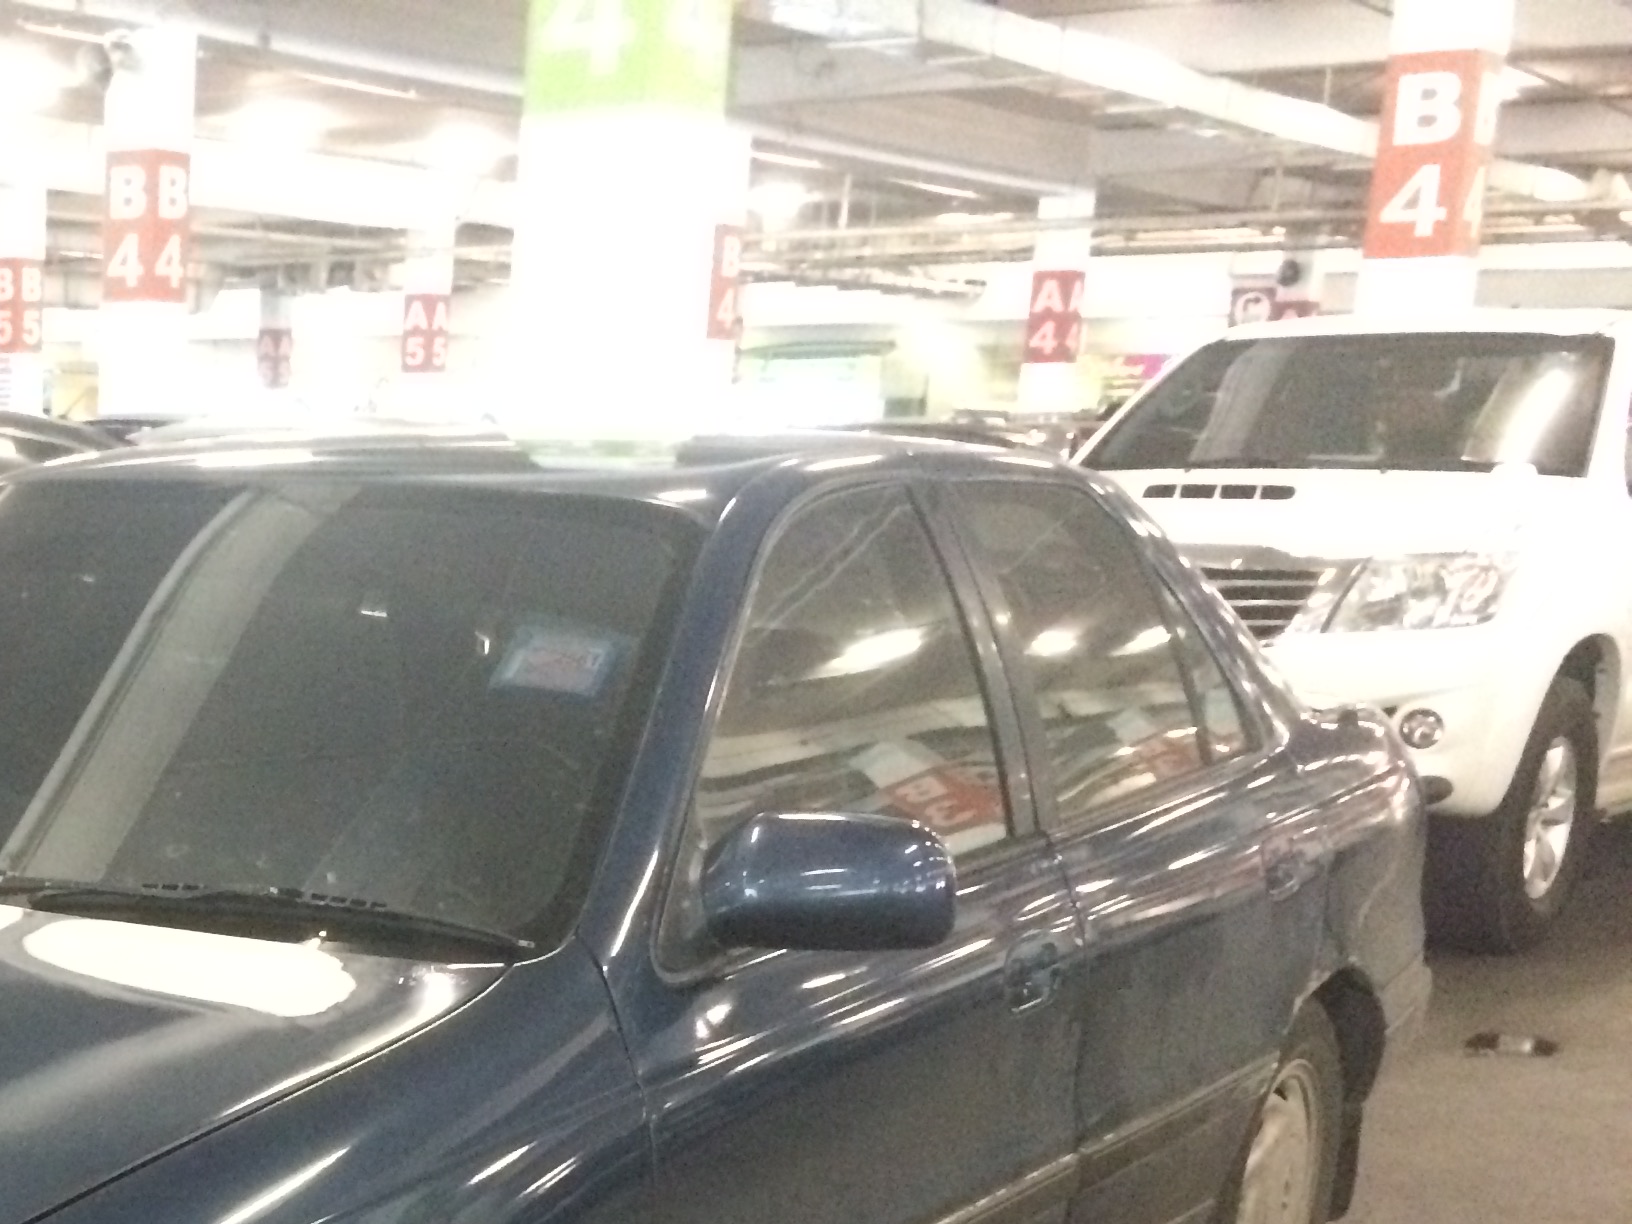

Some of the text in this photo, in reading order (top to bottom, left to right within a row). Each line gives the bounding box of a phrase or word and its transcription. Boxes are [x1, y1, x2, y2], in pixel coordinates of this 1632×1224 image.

[541, 0, 636, 76] 4
[1393, 72, 1462, 145] B
[110, 165, 147, 220] B
[158, 165, 188, 219] B
[1380, 164, 1447, 237] 4
[21, 267, 42, 302] B
[106, 233, 144, 288] 4
[155, 233, 184, 288] 4
[404, 300, 428, 330] A
[1033, 279, 1064, 312] A
[22, 310, 40, 345] 5
[405, 336, 425, 366] 5
[1029, 321, 1058, 355] 4
